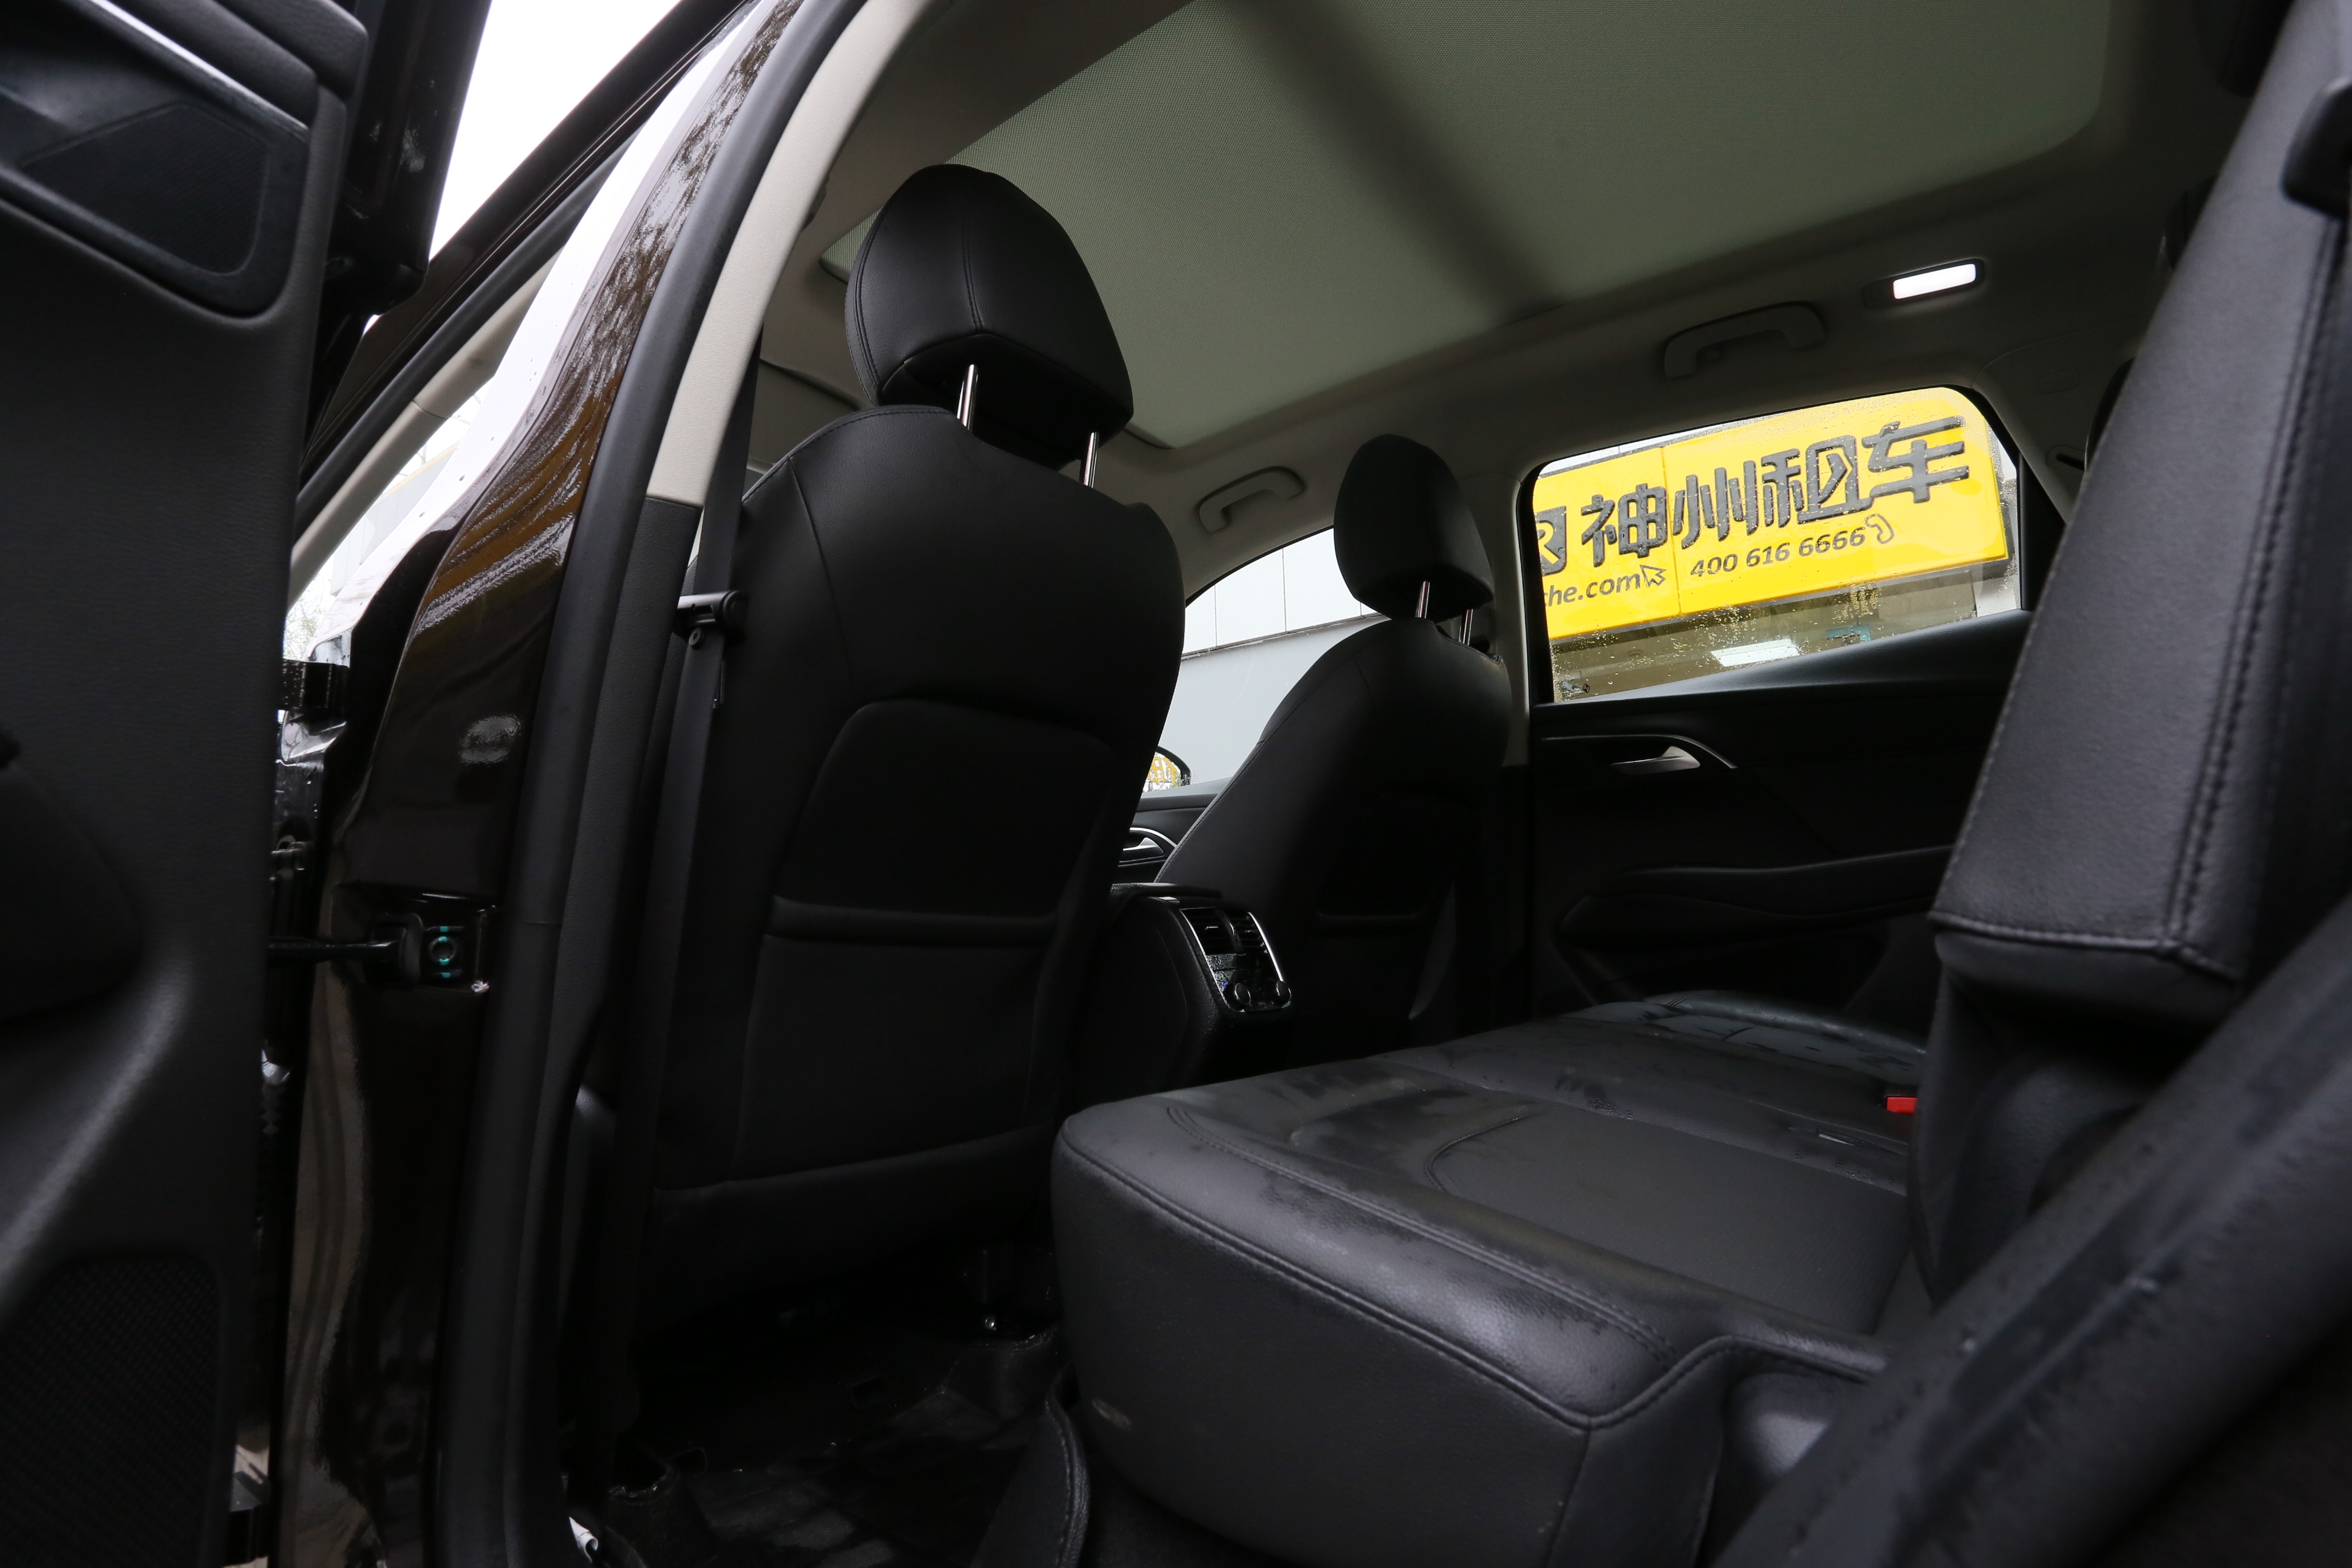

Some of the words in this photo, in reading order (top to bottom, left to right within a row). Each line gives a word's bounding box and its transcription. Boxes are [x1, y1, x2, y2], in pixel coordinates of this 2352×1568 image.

[1581, 416, 1969, 568] 神州租车
[1690, 553, 1738, 577] 400
[1746, 542, 1790, 567] 616
[1798, 526, 1866, 557] 6666
